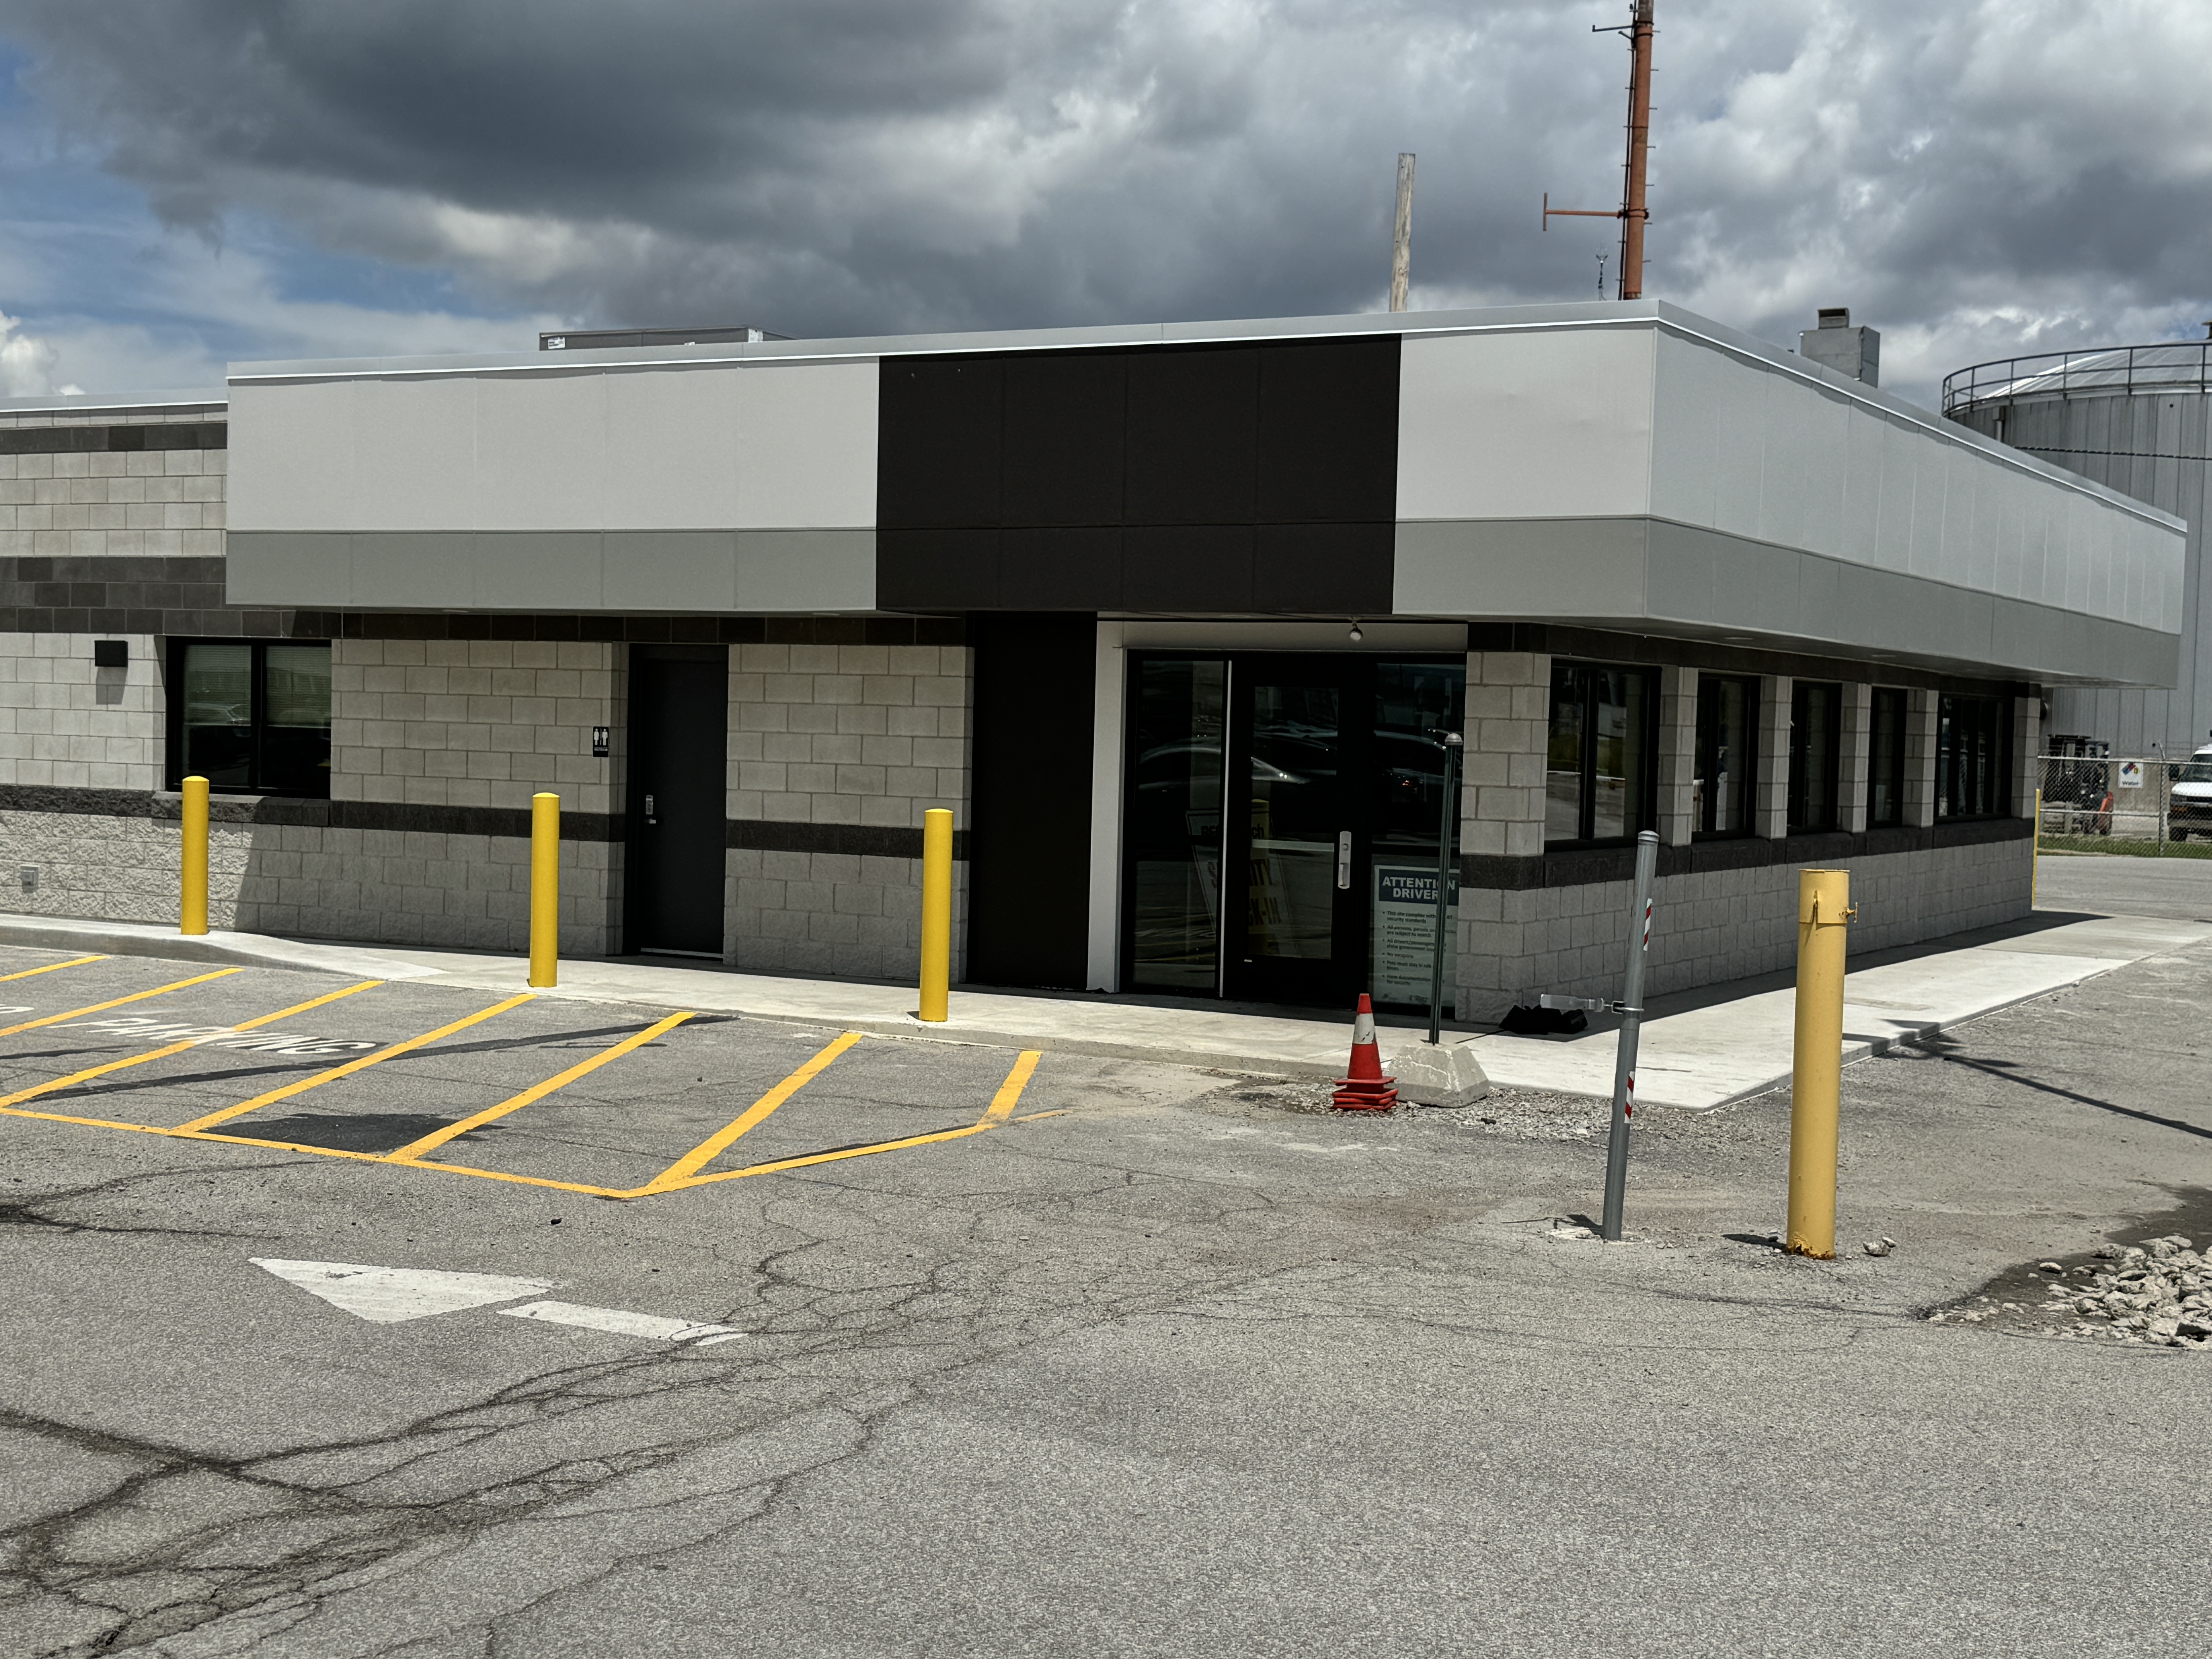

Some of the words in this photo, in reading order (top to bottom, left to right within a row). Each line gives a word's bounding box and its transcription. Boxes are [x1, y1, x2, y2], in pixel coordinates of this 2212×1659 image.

[1382, 876, 1455, 890] ATTENTIN
[1393, 888, 1438, 900] DRIVER
[46, 1017, 376, 1054] PARKING
